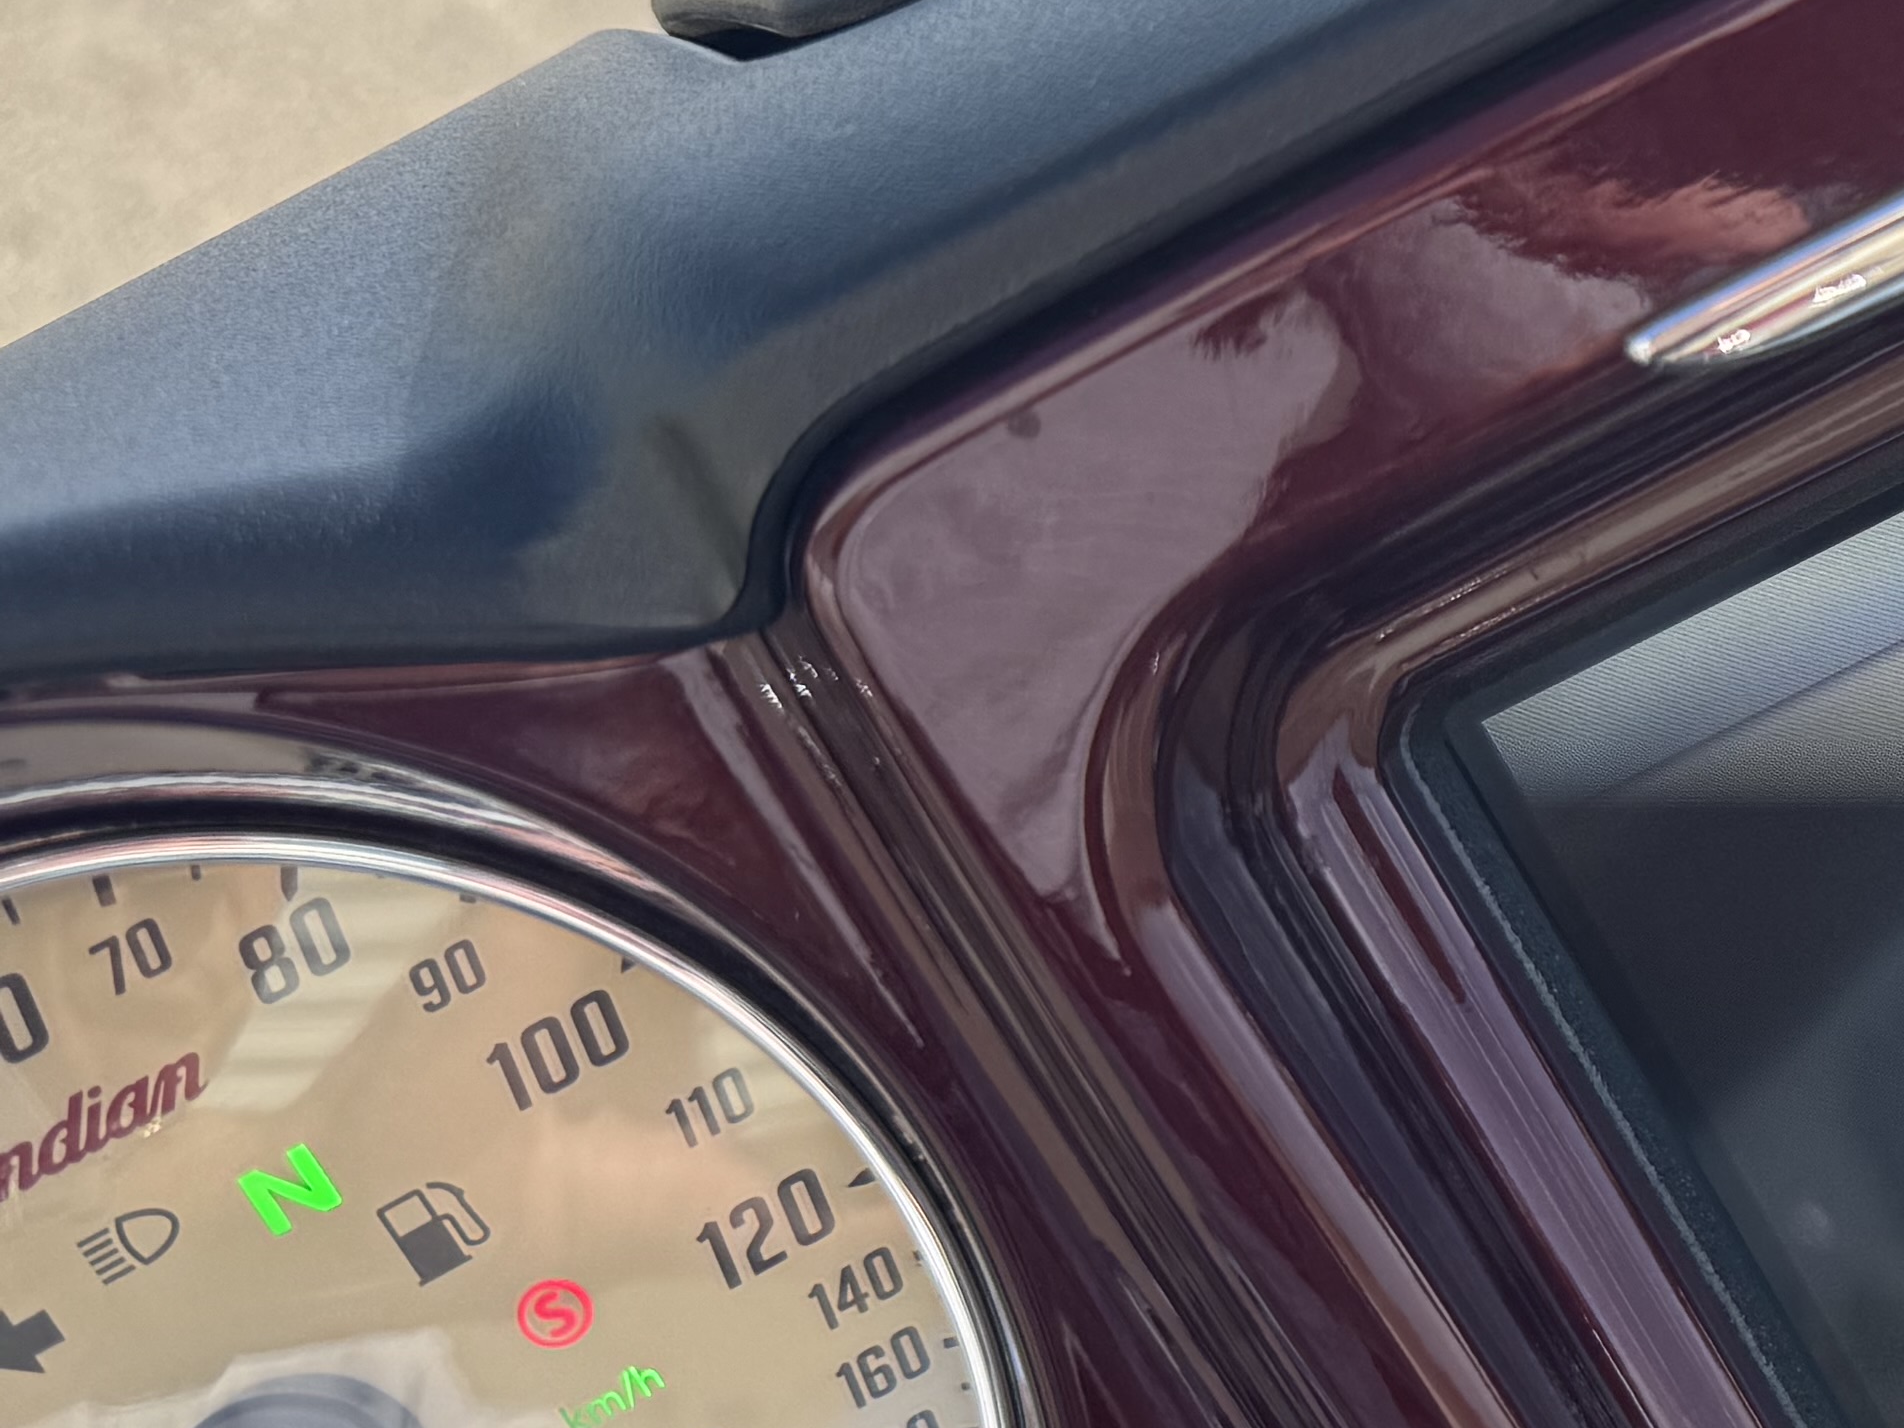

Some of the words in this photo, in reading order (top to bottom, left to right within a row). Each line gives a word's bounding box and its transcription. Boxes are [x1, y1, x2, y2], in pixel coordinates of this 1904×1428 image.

[88, 918, 172, 995] 70
[239, 897, 352, 1006] 80
[408, 938, 487, 1013] 90
[0, 973, 49, 1064] 0
[485, 988, 631, 1110] 100
[0, 1052, 208, 1202] ndian
[665, 1067, 756, 1148] 110
[237, 1142, 342, 1236] N
[694, 1167, 837, 1290] 120
[808, 1245, 904, 1330] 140
[836, 1326, 932, 1409] 160
